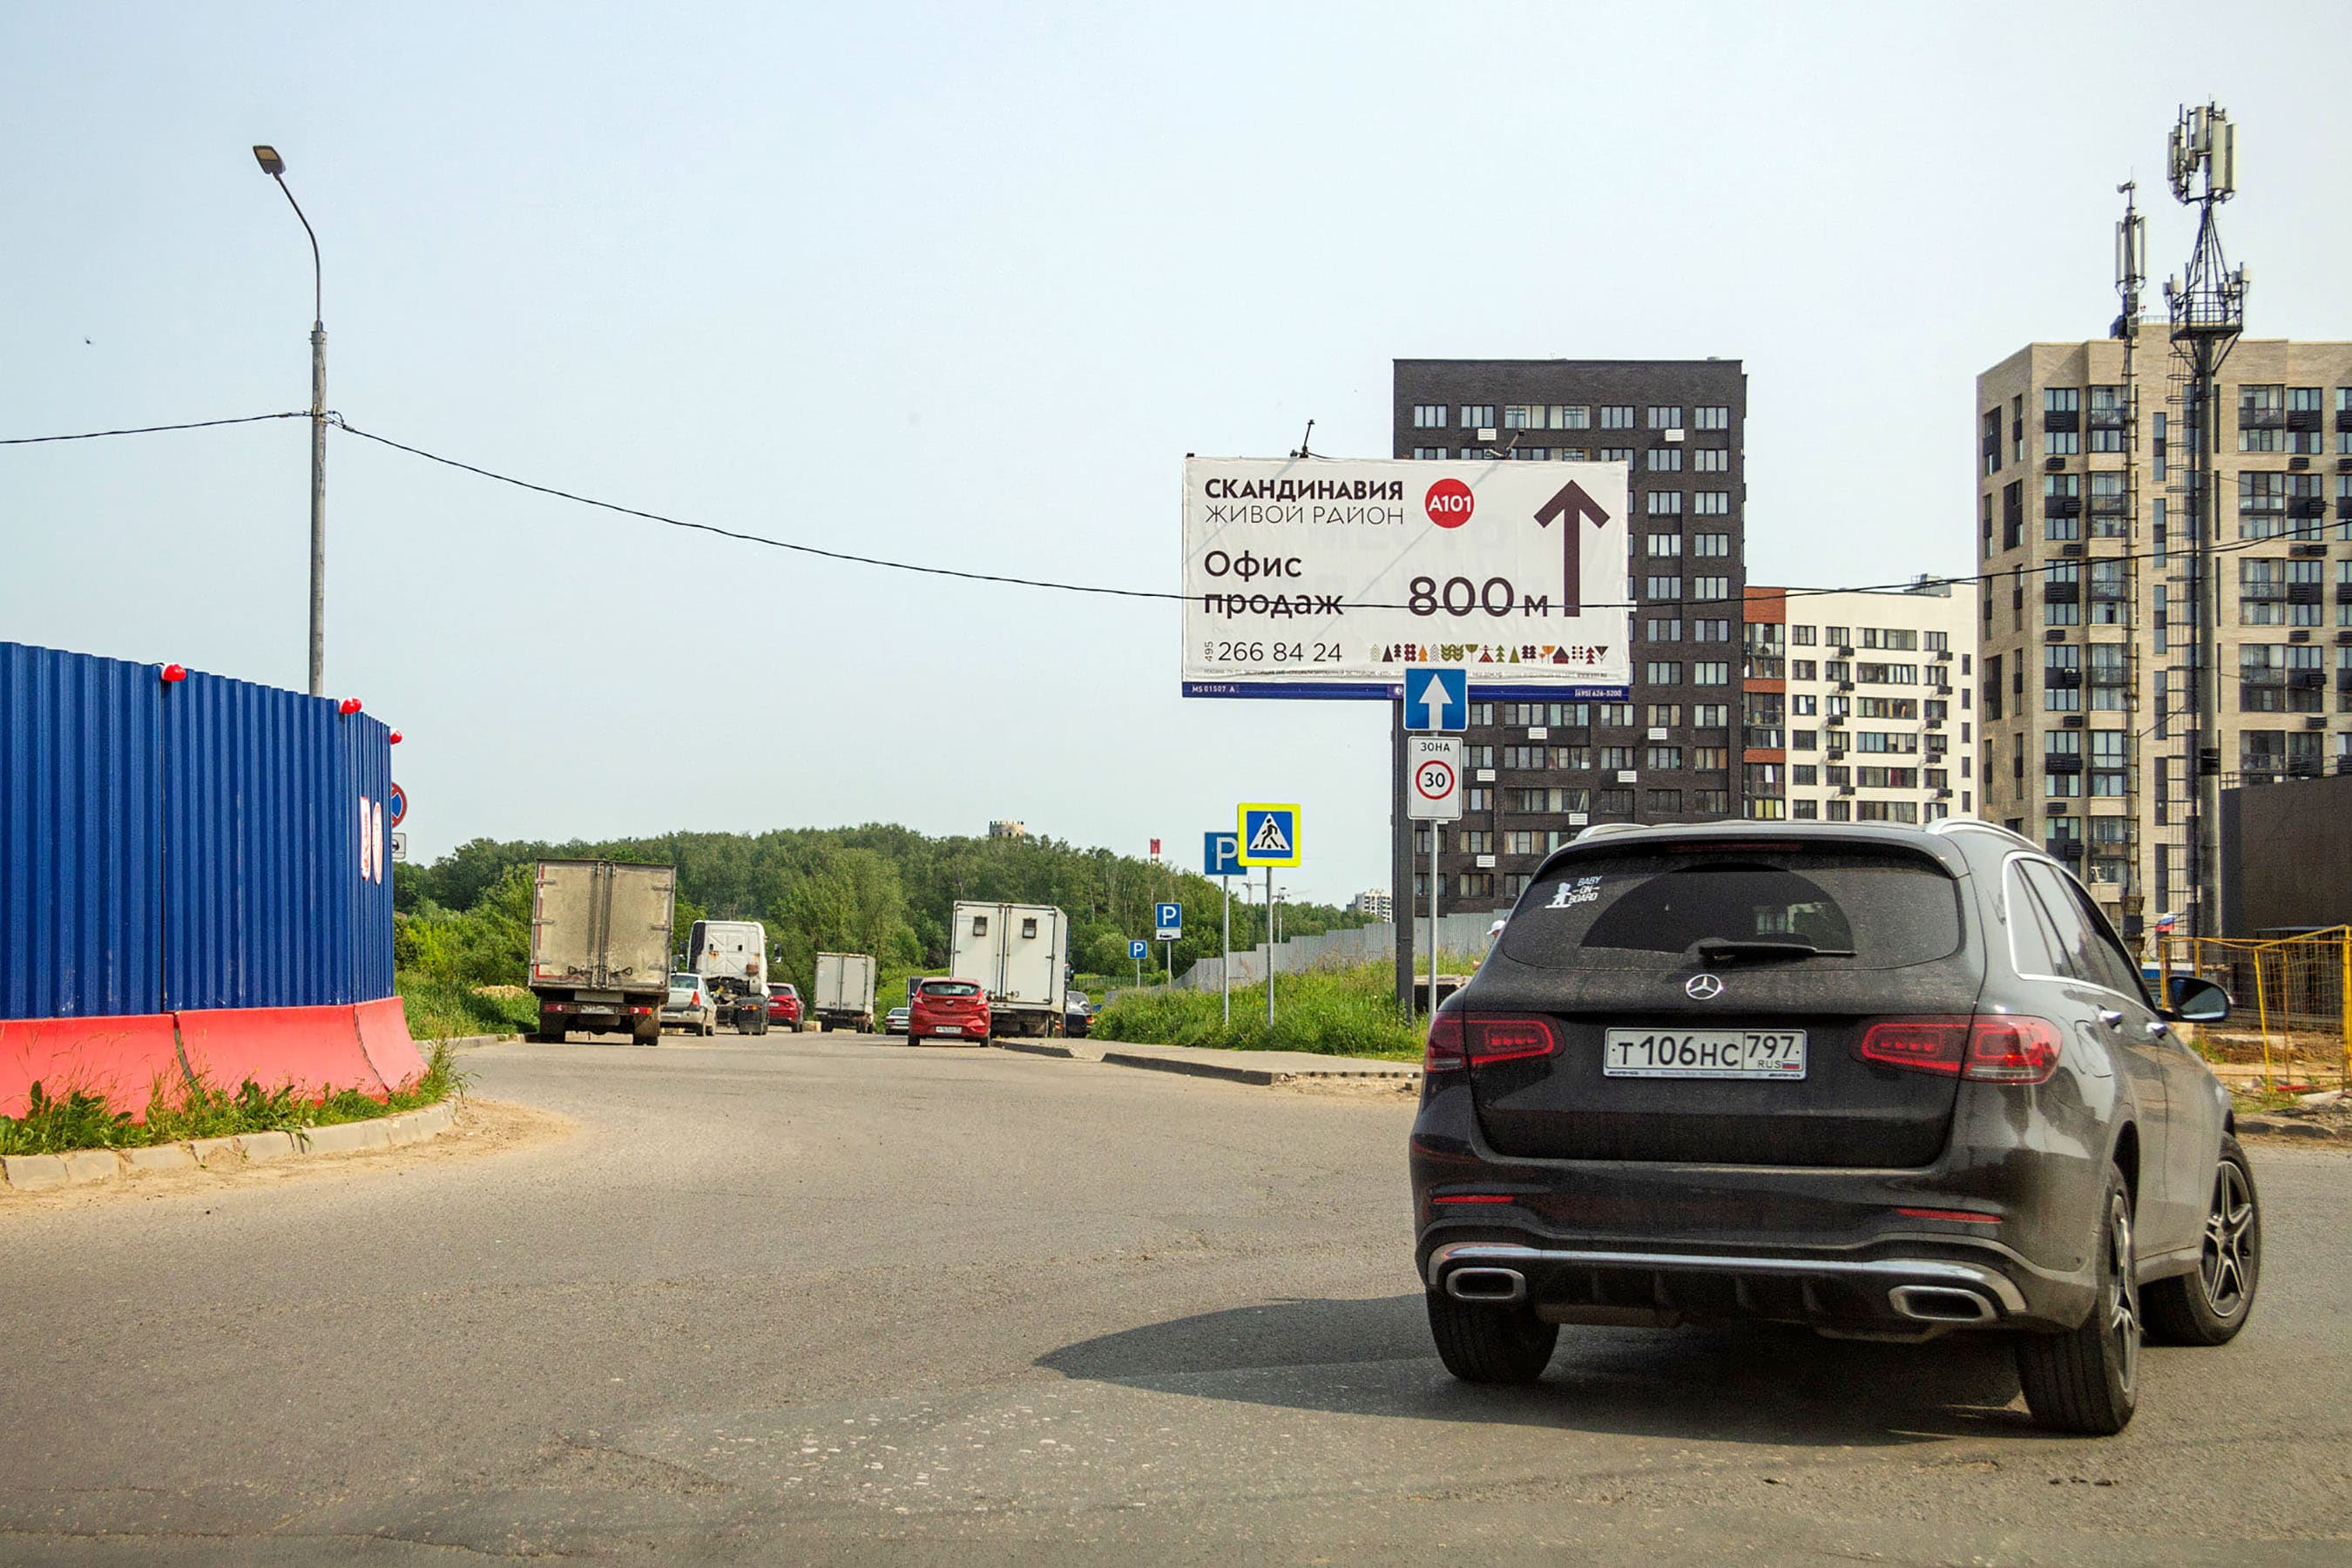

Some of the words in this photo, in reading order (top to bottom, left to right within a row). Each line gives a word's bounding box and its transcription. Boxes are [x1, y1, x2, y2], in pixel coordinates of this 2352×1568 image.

[1205, 478, 1403, 502] СКАНДИНАВИЯ
[1428, 495, 1471, 512] А101
[1205, 504, 1303, 524] ЖИВОЙ
[1313, 506, 1403, 524] РАЙОН
[1204, 550, 1302, 582] Офис
[1204, 593, 1344, 618] продаж
[1409, 576, 1515, 618] 800
[1524, 595, 1548, 618] м
[1205, 641, 1213, 662] 495
[1219, 641, 1264, 661] 266
[1273, 642, 1304, 662] 84
[1313, 642, 1342, 662] 24
[1420, 742, 1450, 752] ЗОНА
[1424, 772, 1446, 787] 30
[1216, 837, 1238, 870] P
[1577, 875, 1604, 887] BABY
[1568, 892, 1598, 904] BOARD
[1163, 906, 1177, 925] P
[1133, 943, 1144, 956] P
[1747, 1035, 1794, 1059] 797
[1757, 1059, 1781, 1069] RUS
